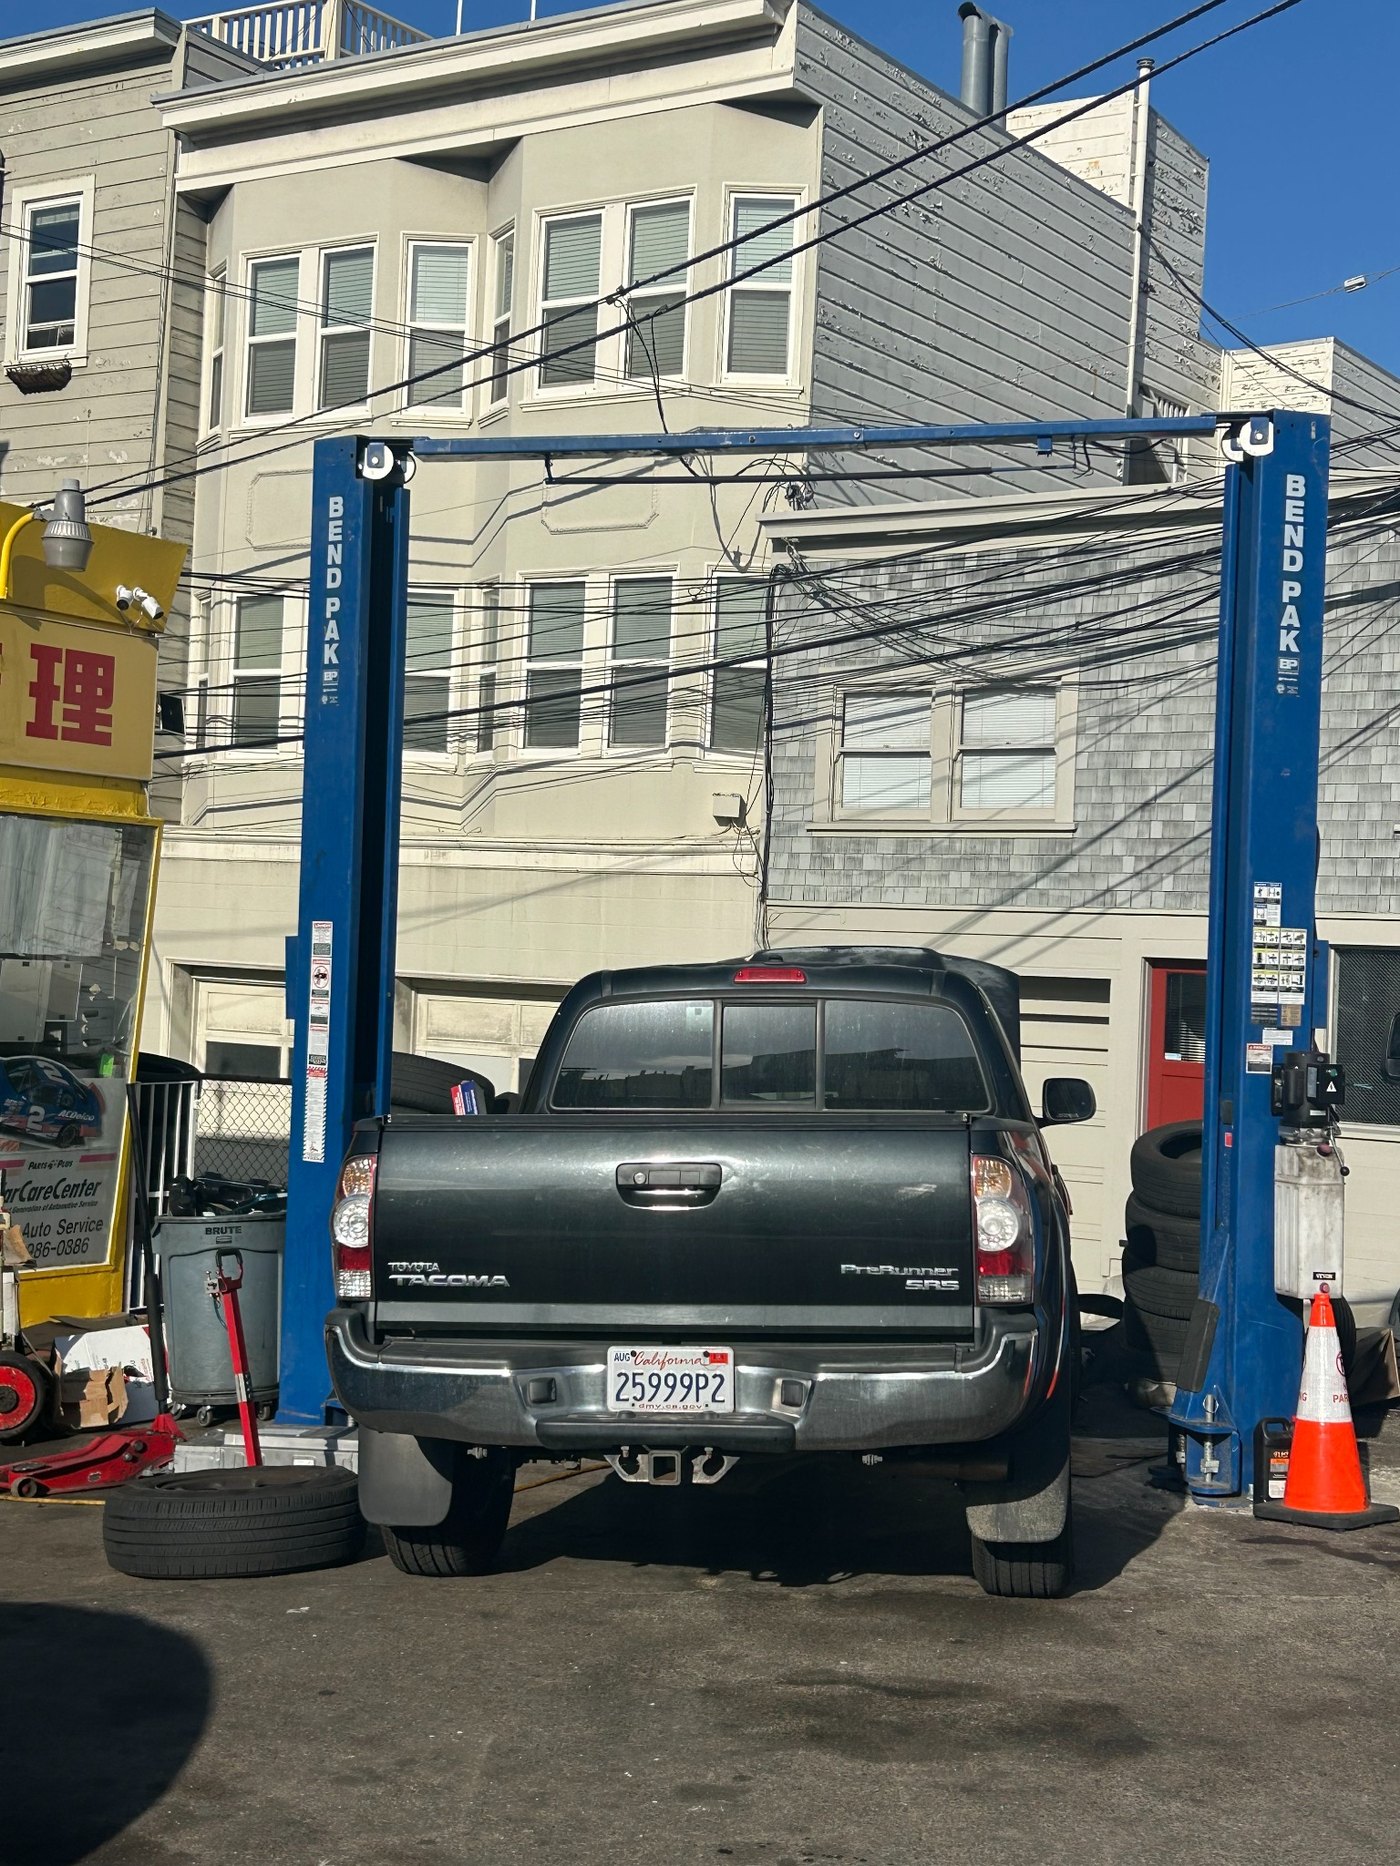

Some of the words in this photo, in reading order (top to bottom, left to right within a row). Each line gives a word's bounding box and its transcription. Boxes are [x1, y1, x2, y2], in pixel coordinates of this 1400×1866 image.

[0, 642, 115, 747] 理
[26, 1105, 45, 1130] 2
[3, 1177, 102, 1203] arCareCenter
[22, 1222, 51, 1238] Auto
[56, 1217, 104, 1235] Service
[205, 1226, 242, 1235] BRUTE
[388, 1261, 440, 1273] TOYOTA
[840, 1264, 959, 1276] PreRunner
[389, 1274, 511, 1287] TACOMA
[613, 1352, 631, 1362] AUG
[633, 1351, 703, 1371] California
[615, 1372, 726, 1403] 25999P2
